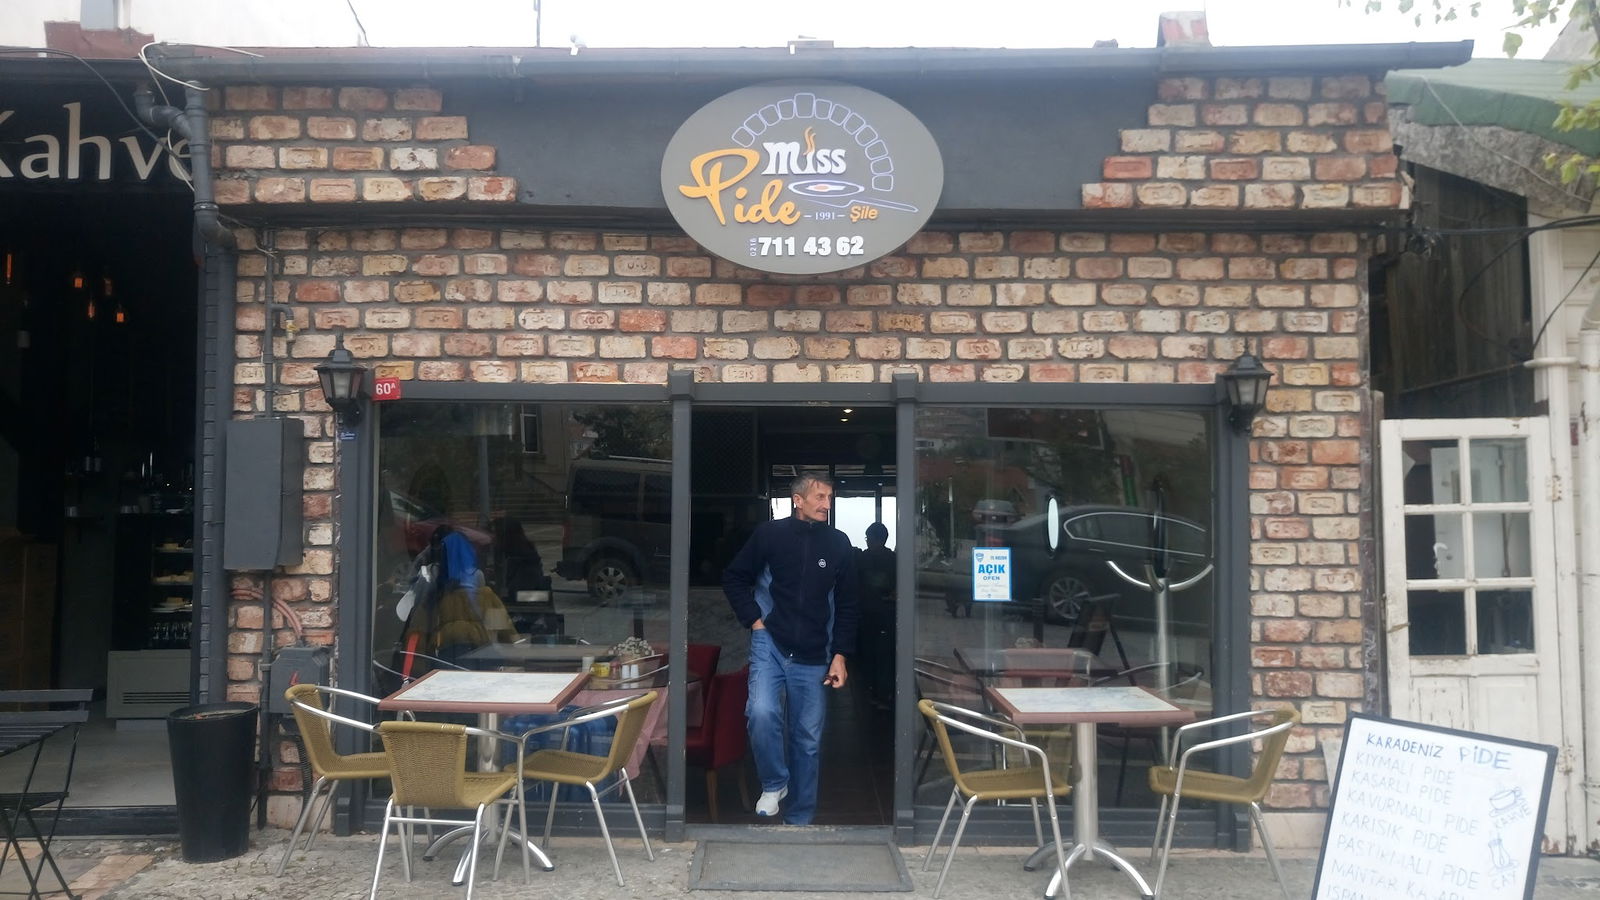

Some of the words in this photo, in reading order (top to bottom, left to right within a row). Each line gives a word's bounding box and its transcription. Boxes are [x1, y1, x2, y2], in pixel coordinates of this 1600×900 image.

[679, 148, 800, 225] Pide
[850, 205, 878, 222] Şile
[759, 236, 795, 256] 711
[803, 236, 831, 256] 43
[836, 235, 864, 256] 62
[977, 563, 1006, 576] AÇIK
